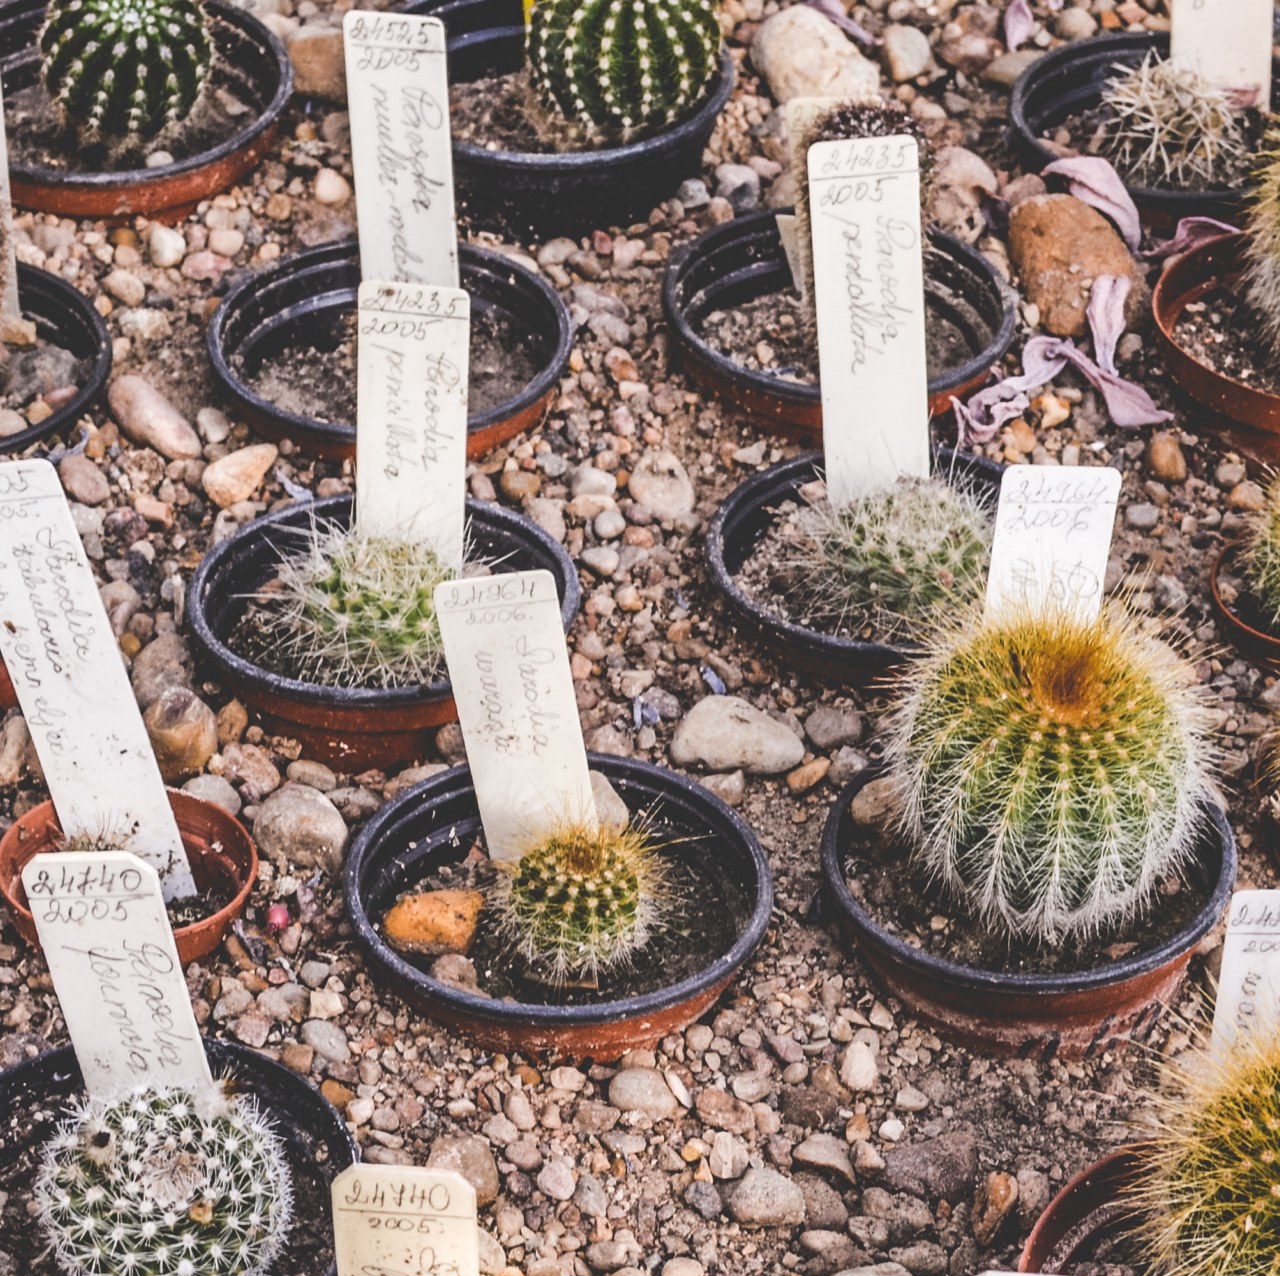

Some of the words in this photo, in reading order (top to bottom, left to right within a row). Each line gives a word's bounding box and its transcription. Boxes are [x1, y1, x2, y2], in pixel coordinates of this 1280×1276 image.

[821, 142, 916, 175] 24235
[819, 176, 899, 206] 2005
[873, 214, 917, 345] Parodia
[361, 318, 443, 342] 2005
[421, 349, 461, 473] Parodia
[29, 866, 143, 897] 24740
[41, 899, 128, 924] 2005
[122, 938, 196, 1069] Parodia
